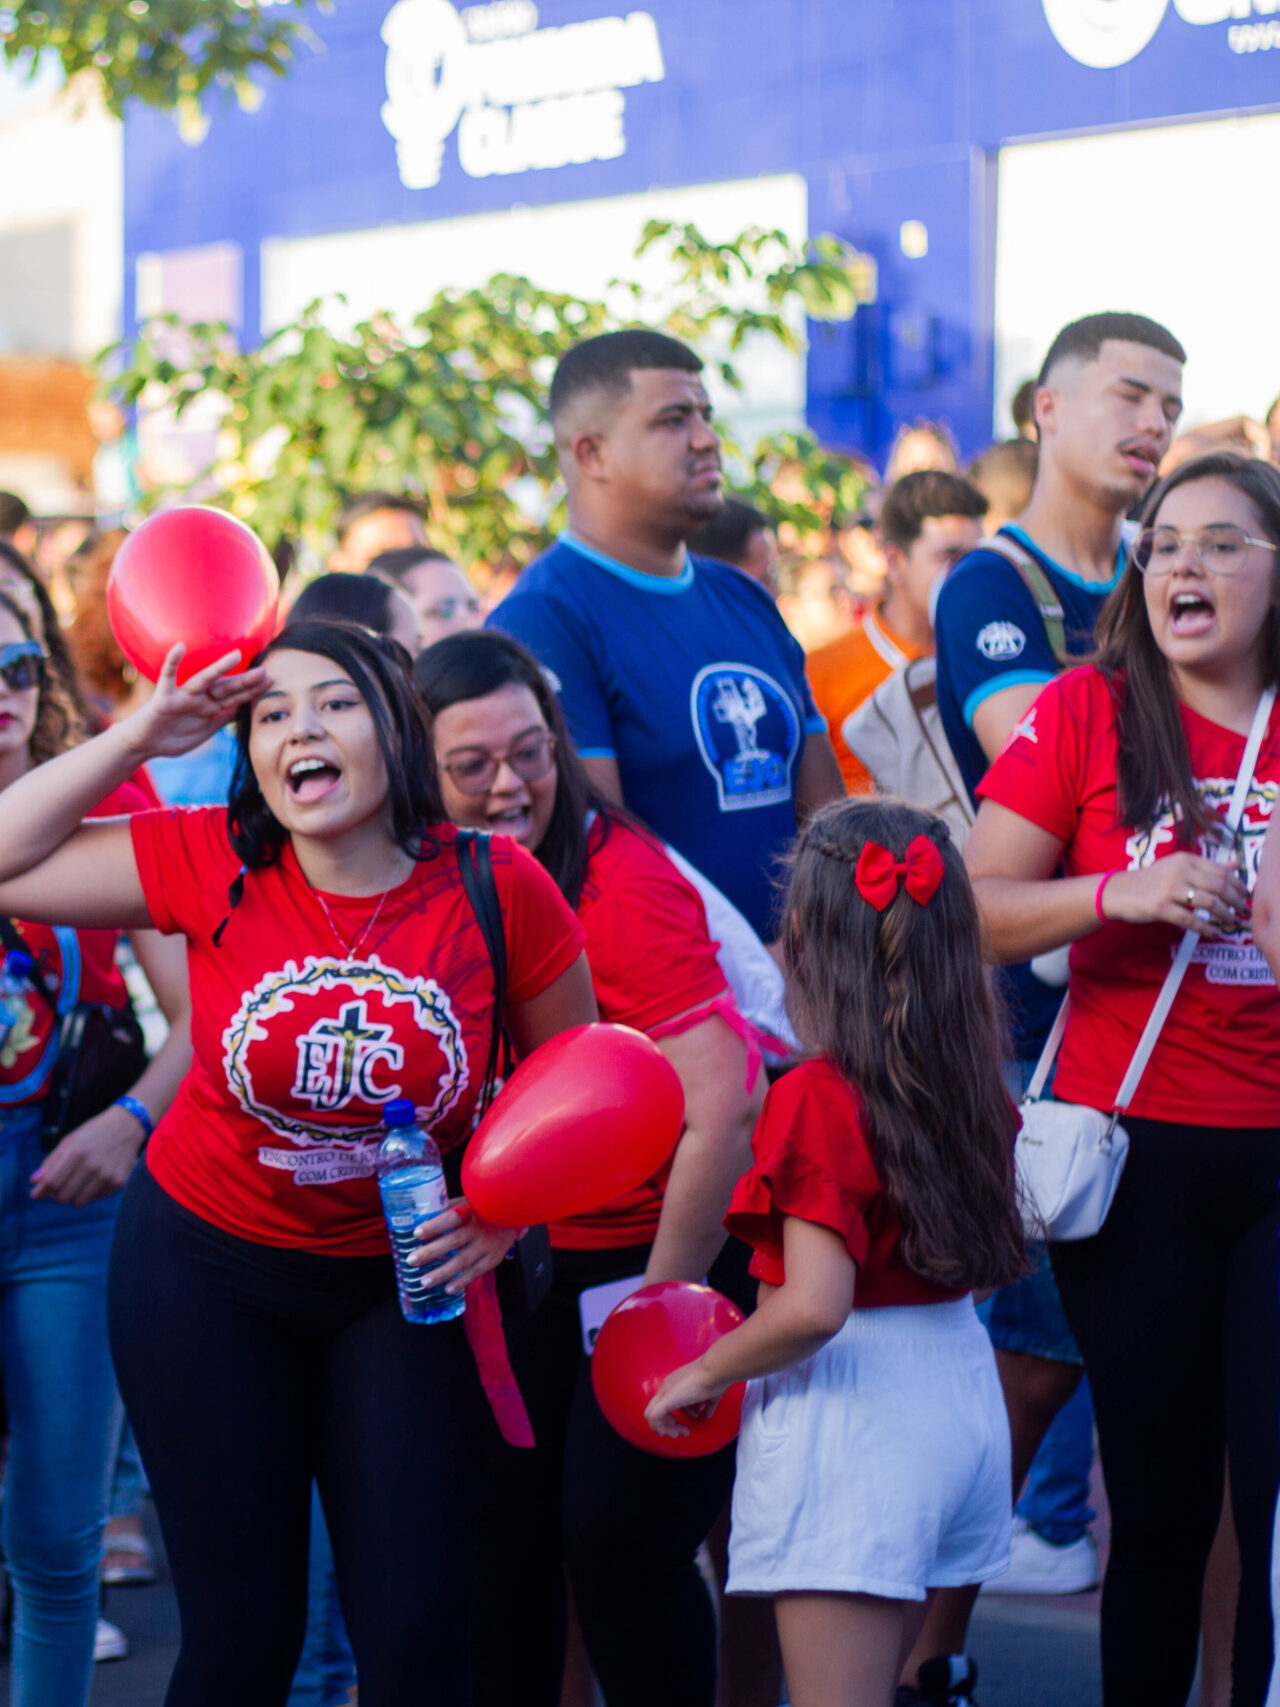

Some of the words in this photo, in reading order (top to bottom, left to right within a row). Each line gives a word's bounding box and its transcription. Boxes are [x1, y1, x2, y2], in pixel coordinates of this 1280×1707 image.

[1210, 966, 1238, 979] COM
[1241, 967, 1272, 980] CRIST
[295, 1040, 400, 1110] EJC
[263, 1150, 335, 1167] ENCONTRO
[339, 1151, 355, 1162] DE
[298, 1169, 327, 1182] COM
[330, 1165, 371, 1179] CRISTO
